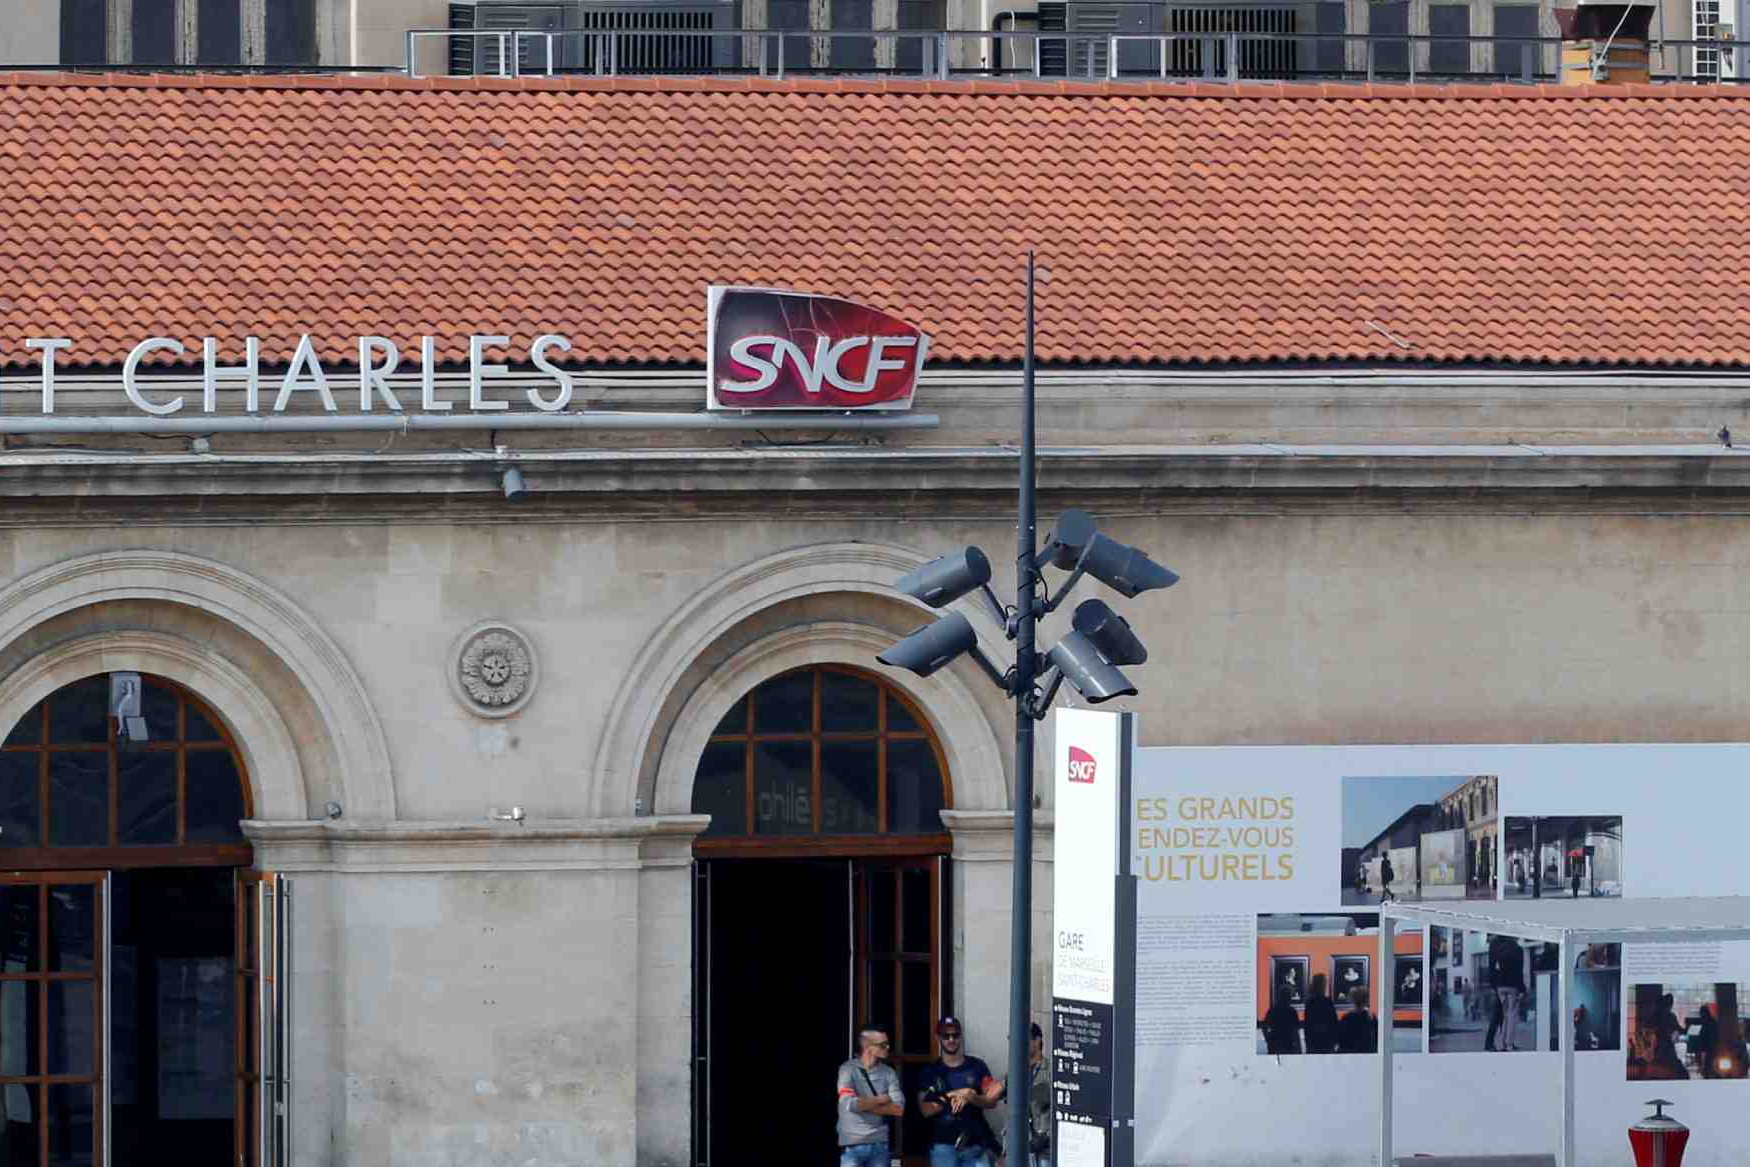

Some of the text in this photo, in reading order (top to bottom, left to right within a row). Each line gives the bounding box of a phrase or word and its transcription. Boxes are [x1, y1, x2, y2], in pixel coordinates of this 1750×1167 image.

[122, 334, 573, 416] CHARLES
[720, 335, 917, 393] SNCF
[1069, 760, 1096, 778] SNCF
[1177, 797, 1293, 820] GRANDS
[1136, 854, 1293, 880] ULTURELS
[1058, 931, 1085, 951] GARE
